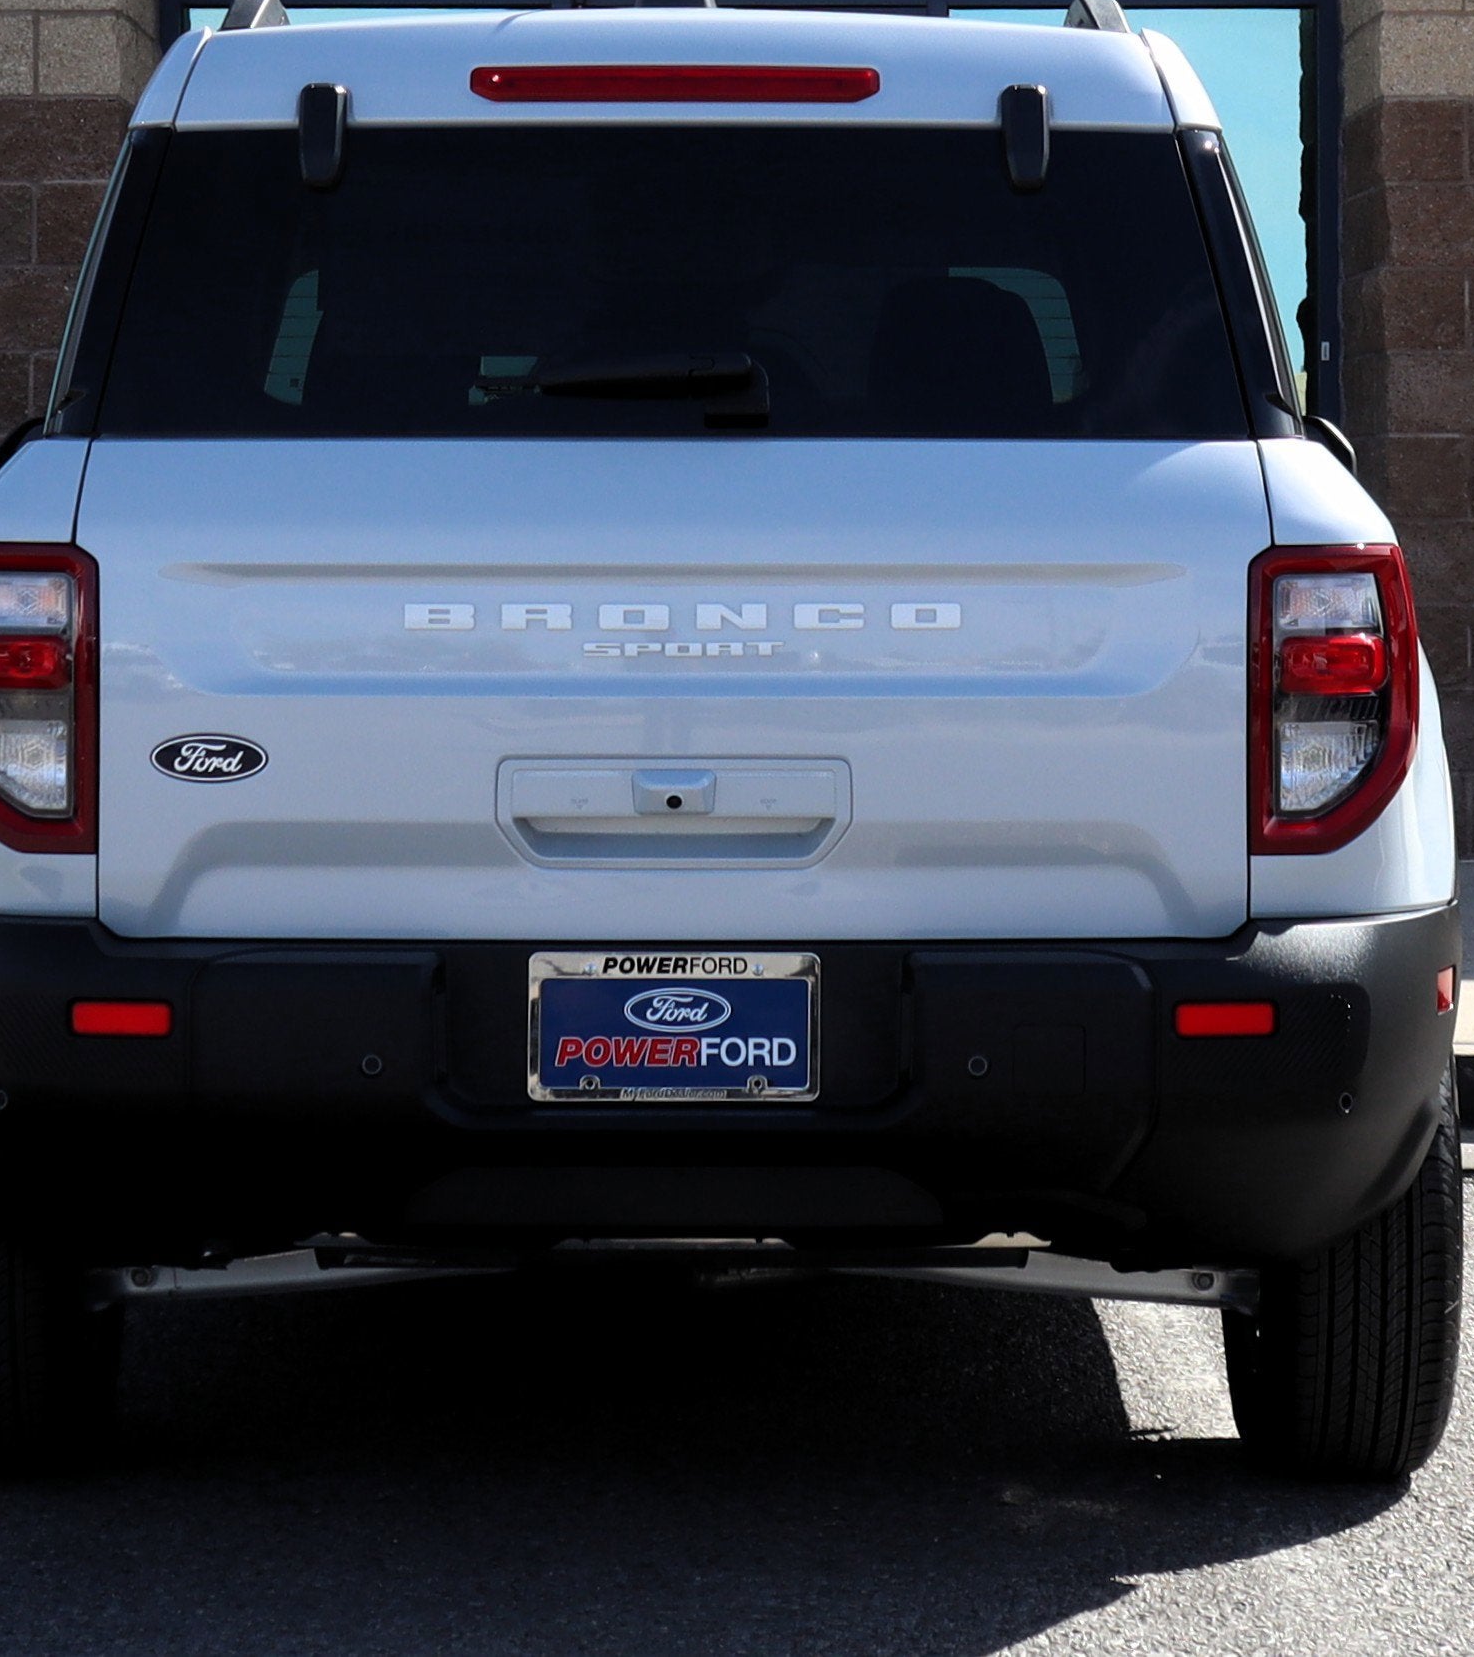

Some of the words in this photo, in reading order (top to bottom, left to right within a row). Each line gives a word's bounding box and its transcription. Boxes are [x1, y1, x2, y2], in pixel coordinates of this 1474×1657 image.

[403, 602, 962, 631] BRONCO
[582, 641, 786, 658] SPORT
[173, 742, 245, 773] Ford
[645, 994, 710, 1023] Ford
